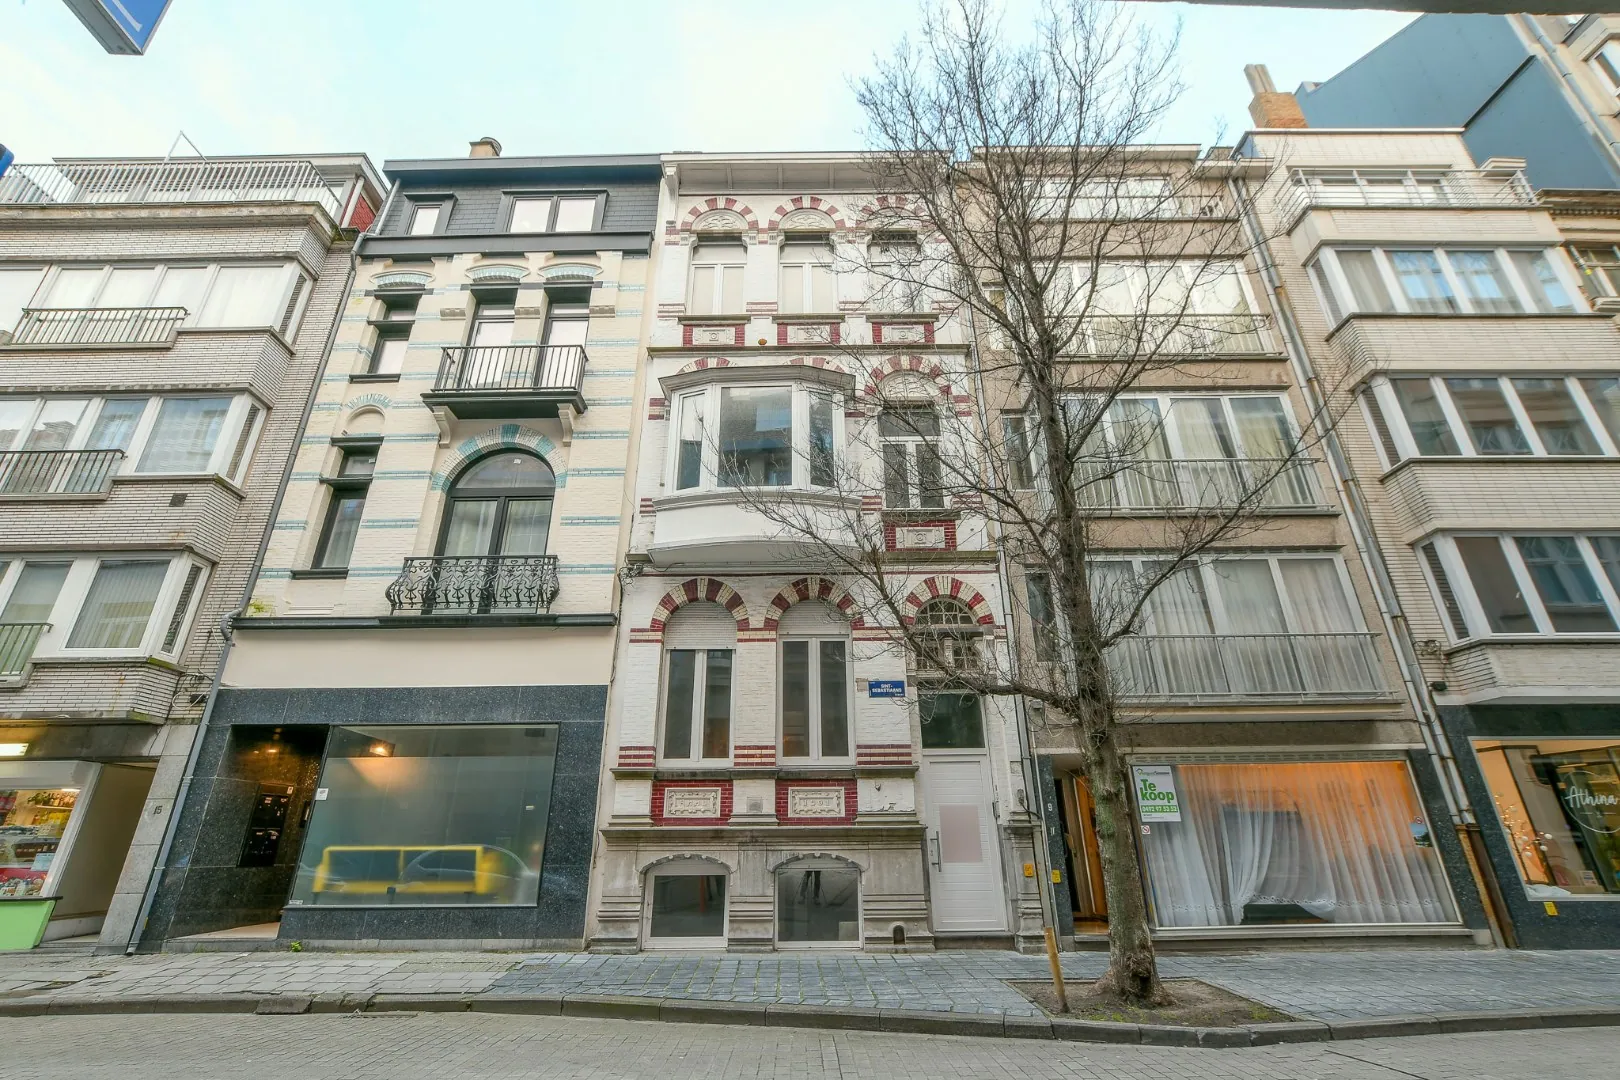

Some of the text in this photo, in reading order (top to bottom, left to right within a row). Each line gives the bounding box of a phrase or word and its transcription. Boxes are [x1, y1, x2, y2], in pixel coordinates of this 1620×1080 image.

[1140, 779, 1157, 791] Te
[1140, 787, 1174, 803] koop
[1564, 785, 1618, 808] Athina
[153, 805, 163, 815] 15
[1047, 803, 1053, 812] 9
